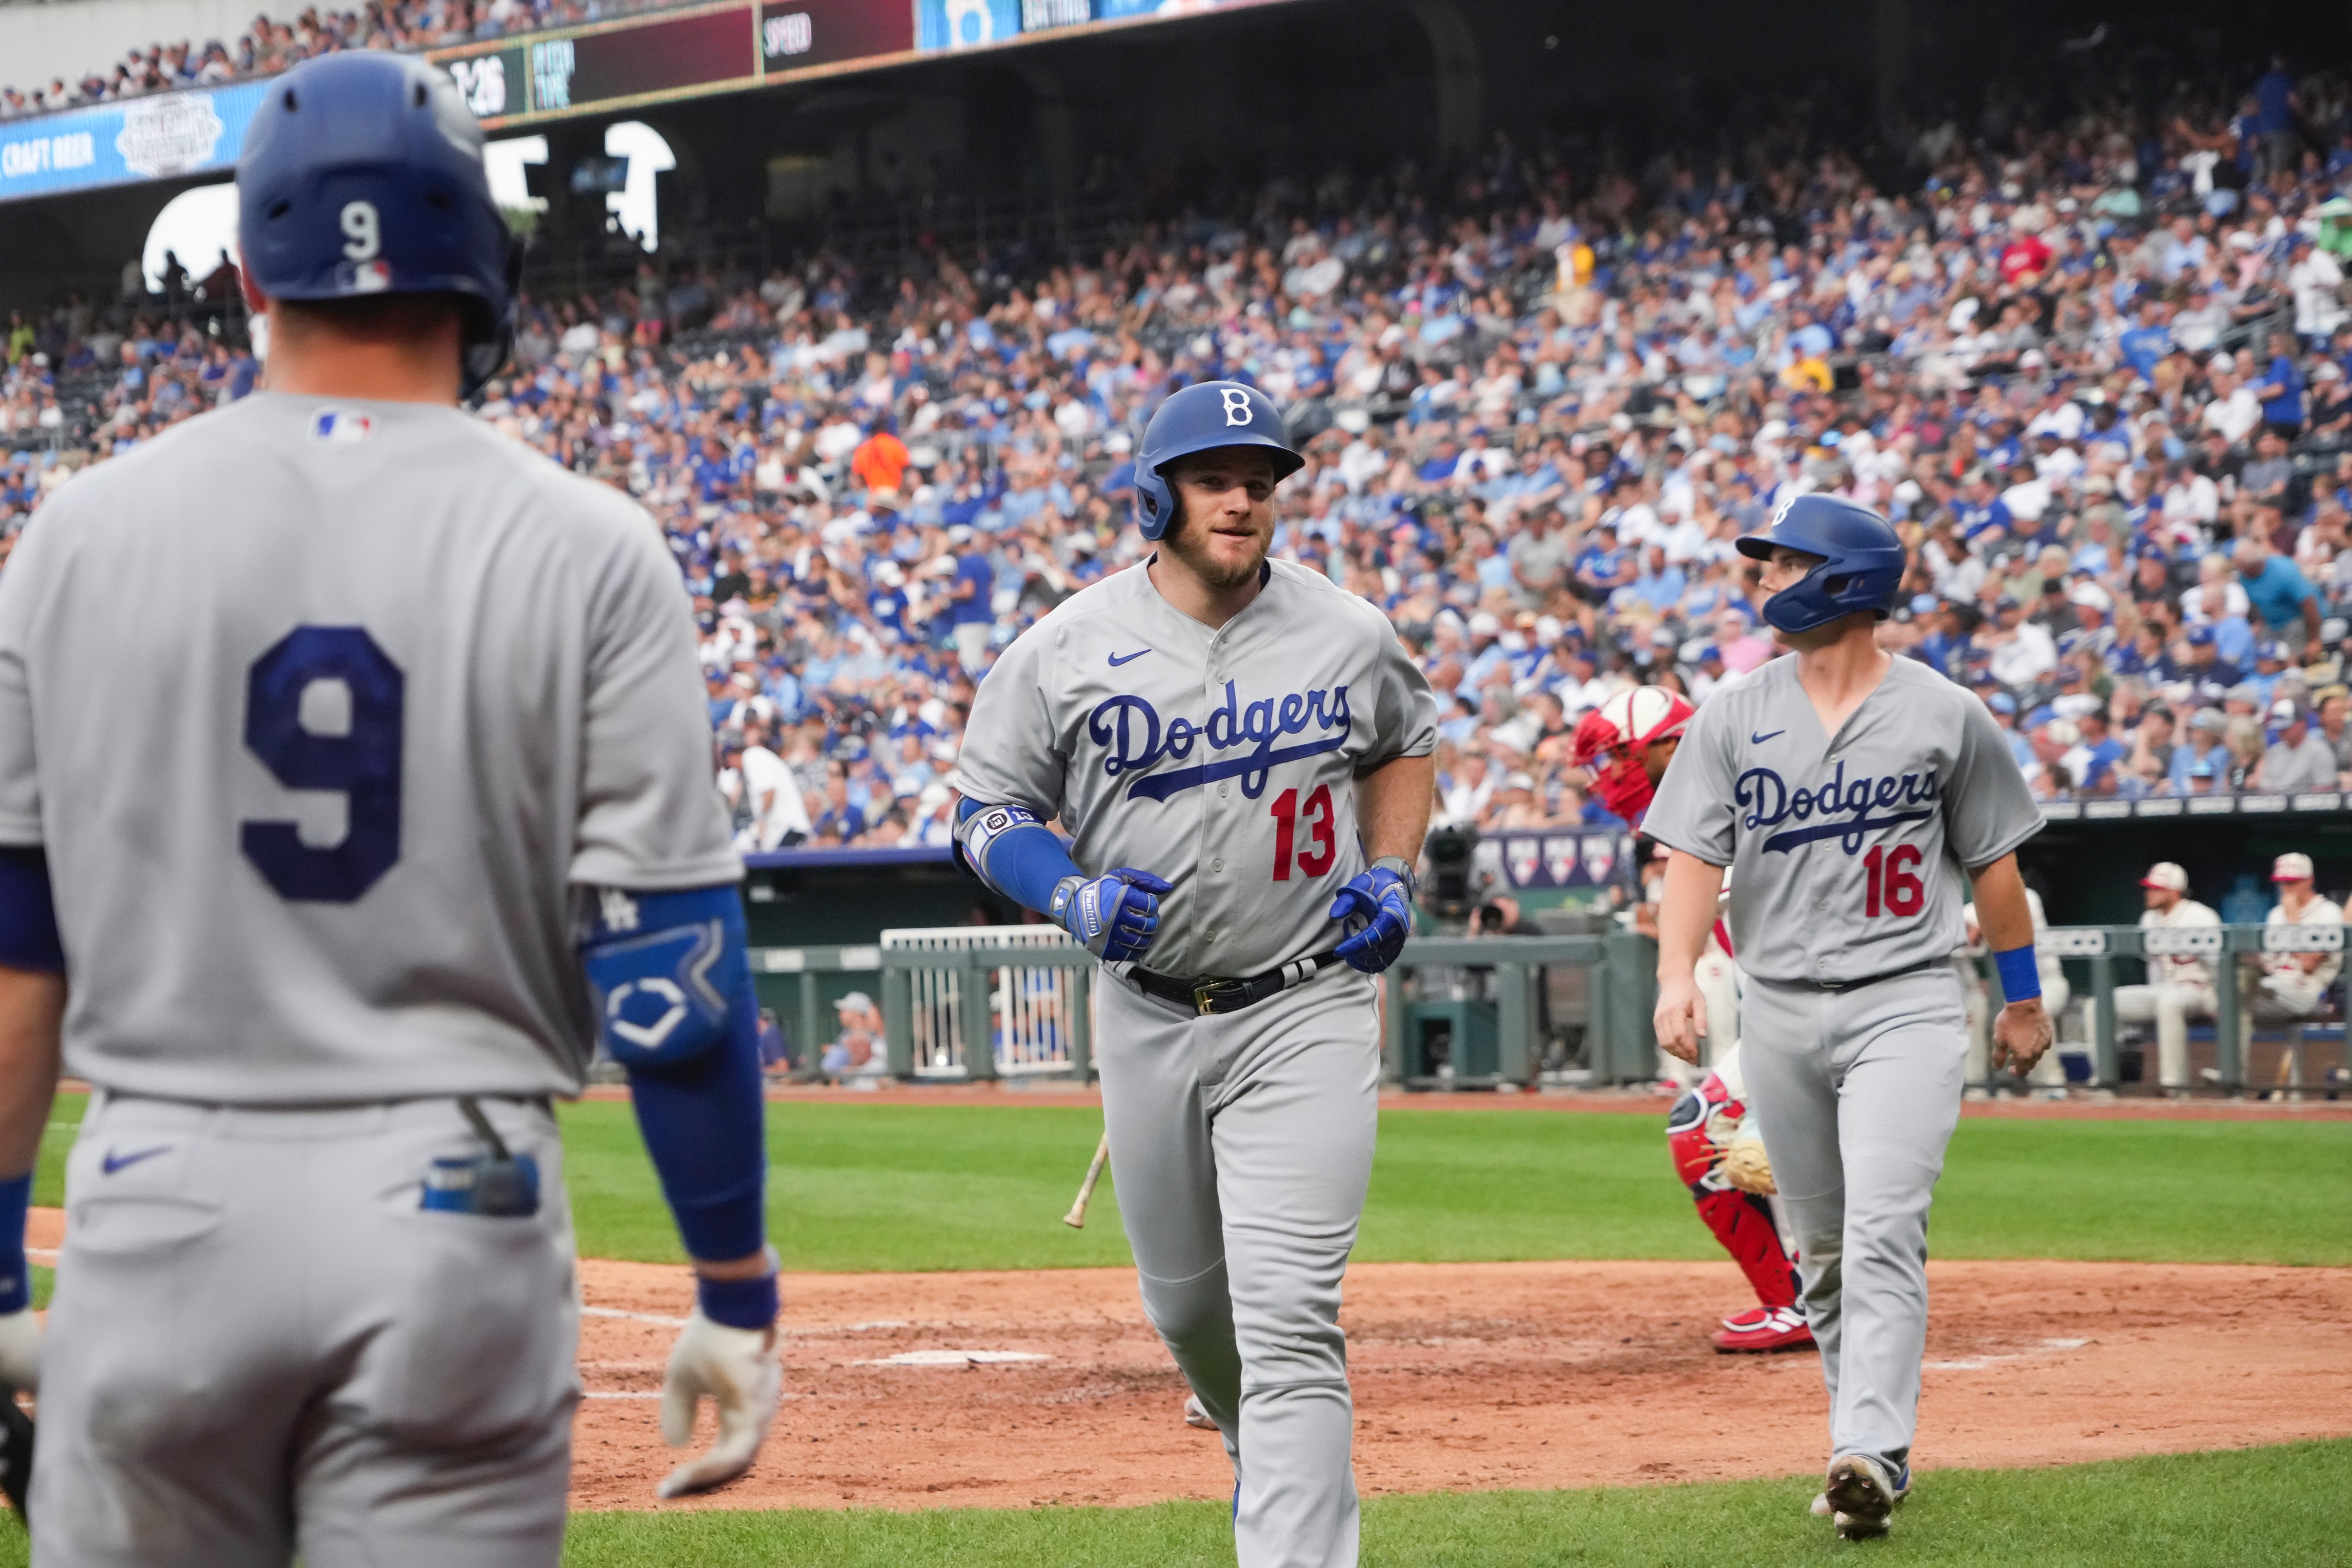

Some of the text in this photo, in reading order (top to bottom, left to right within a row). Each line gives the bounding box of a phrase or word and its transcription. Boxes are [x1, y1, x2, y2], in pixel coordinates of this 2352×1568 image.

[2, 138, 51, 177] CRAFT
[52, 131, 92, 171] BEER
[340, 201, 381, 261] 9
[1220, 389, 1254, 426] B
[1771, 497, 1796, 527] B
[239, 624, 408, 906] 9
[1088, 679, 1352, 800] Dodgers
[1012, 811, 1034, 821] 13
[1270, 783, 1336, 881] 13
[1734, 759, 1937, 856] Dodgers
[1084, 889, 1097, 932] Franklin
[1863, 843, 1925, 918] 16
